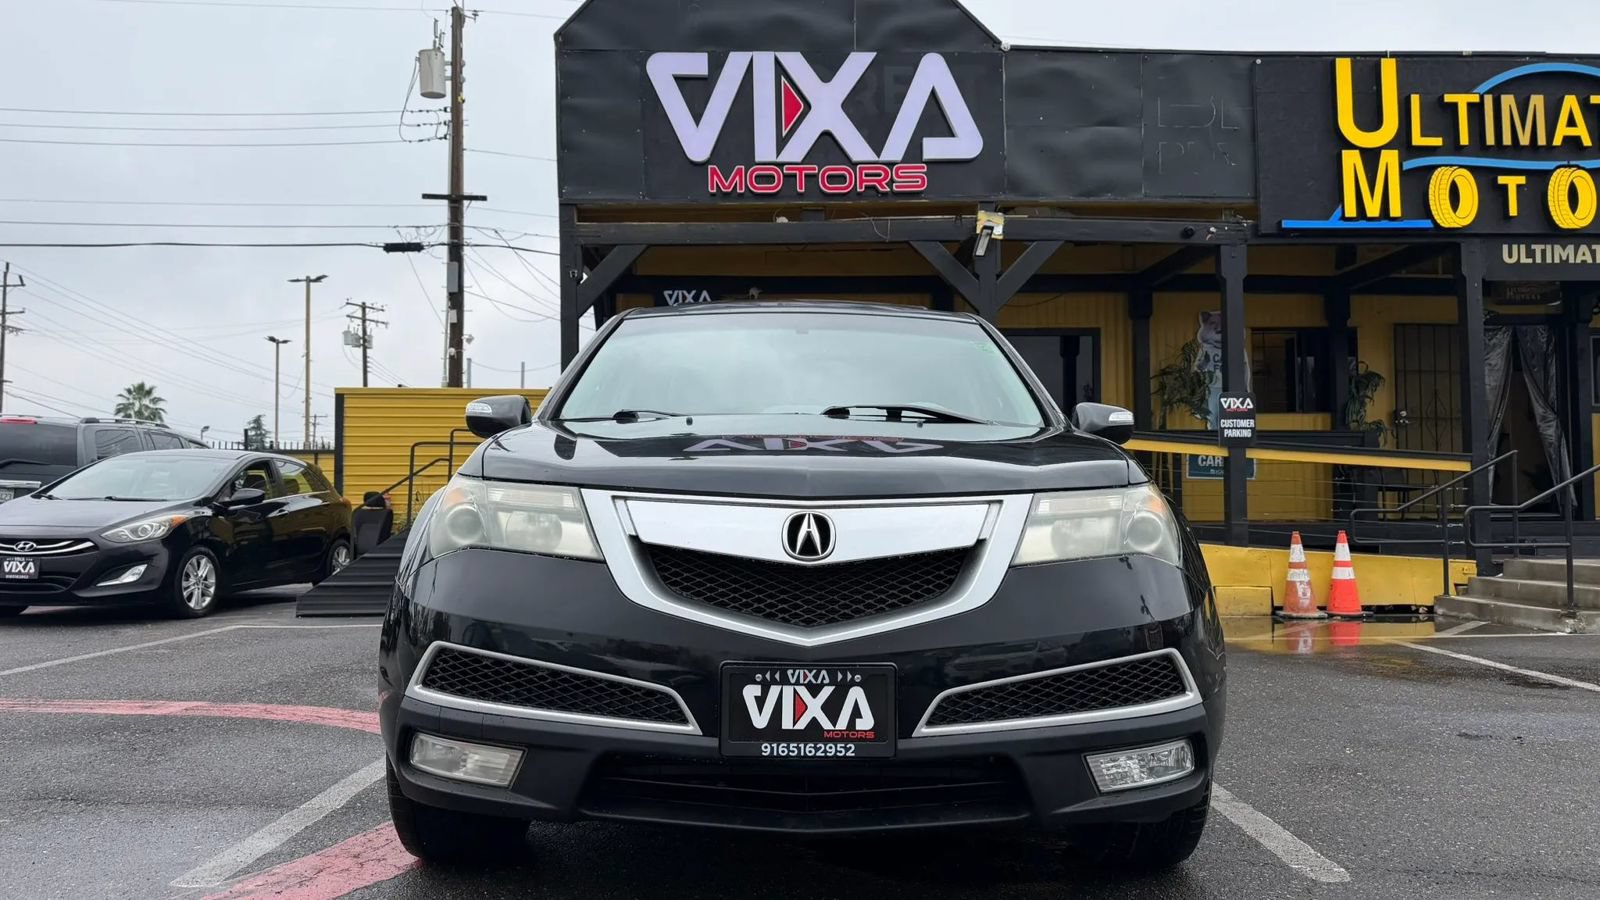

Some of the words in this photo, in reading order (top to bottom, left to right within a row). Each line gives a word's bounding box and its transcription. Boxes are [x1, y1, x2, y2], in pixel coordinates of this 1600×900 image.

[646, 51, 984, 163] VIXA
[1335, 57, 1600, 148] ULTIMA
[708, 164, 928, 193] MOTORS
[663, 290, 711, 306] VIXA
[1220, 397, 1254, 409] VIXA
[1220, 419, 1255, 428] CUSTOMER
[1224, 429, 1252, 437] PARKING
[3, 561, 35, 573] VIXA
[787, 669, 830, 684] VIXA
[742, 684, 875, 730] VIXA
[761, 743, 855, 756] 9165162952
